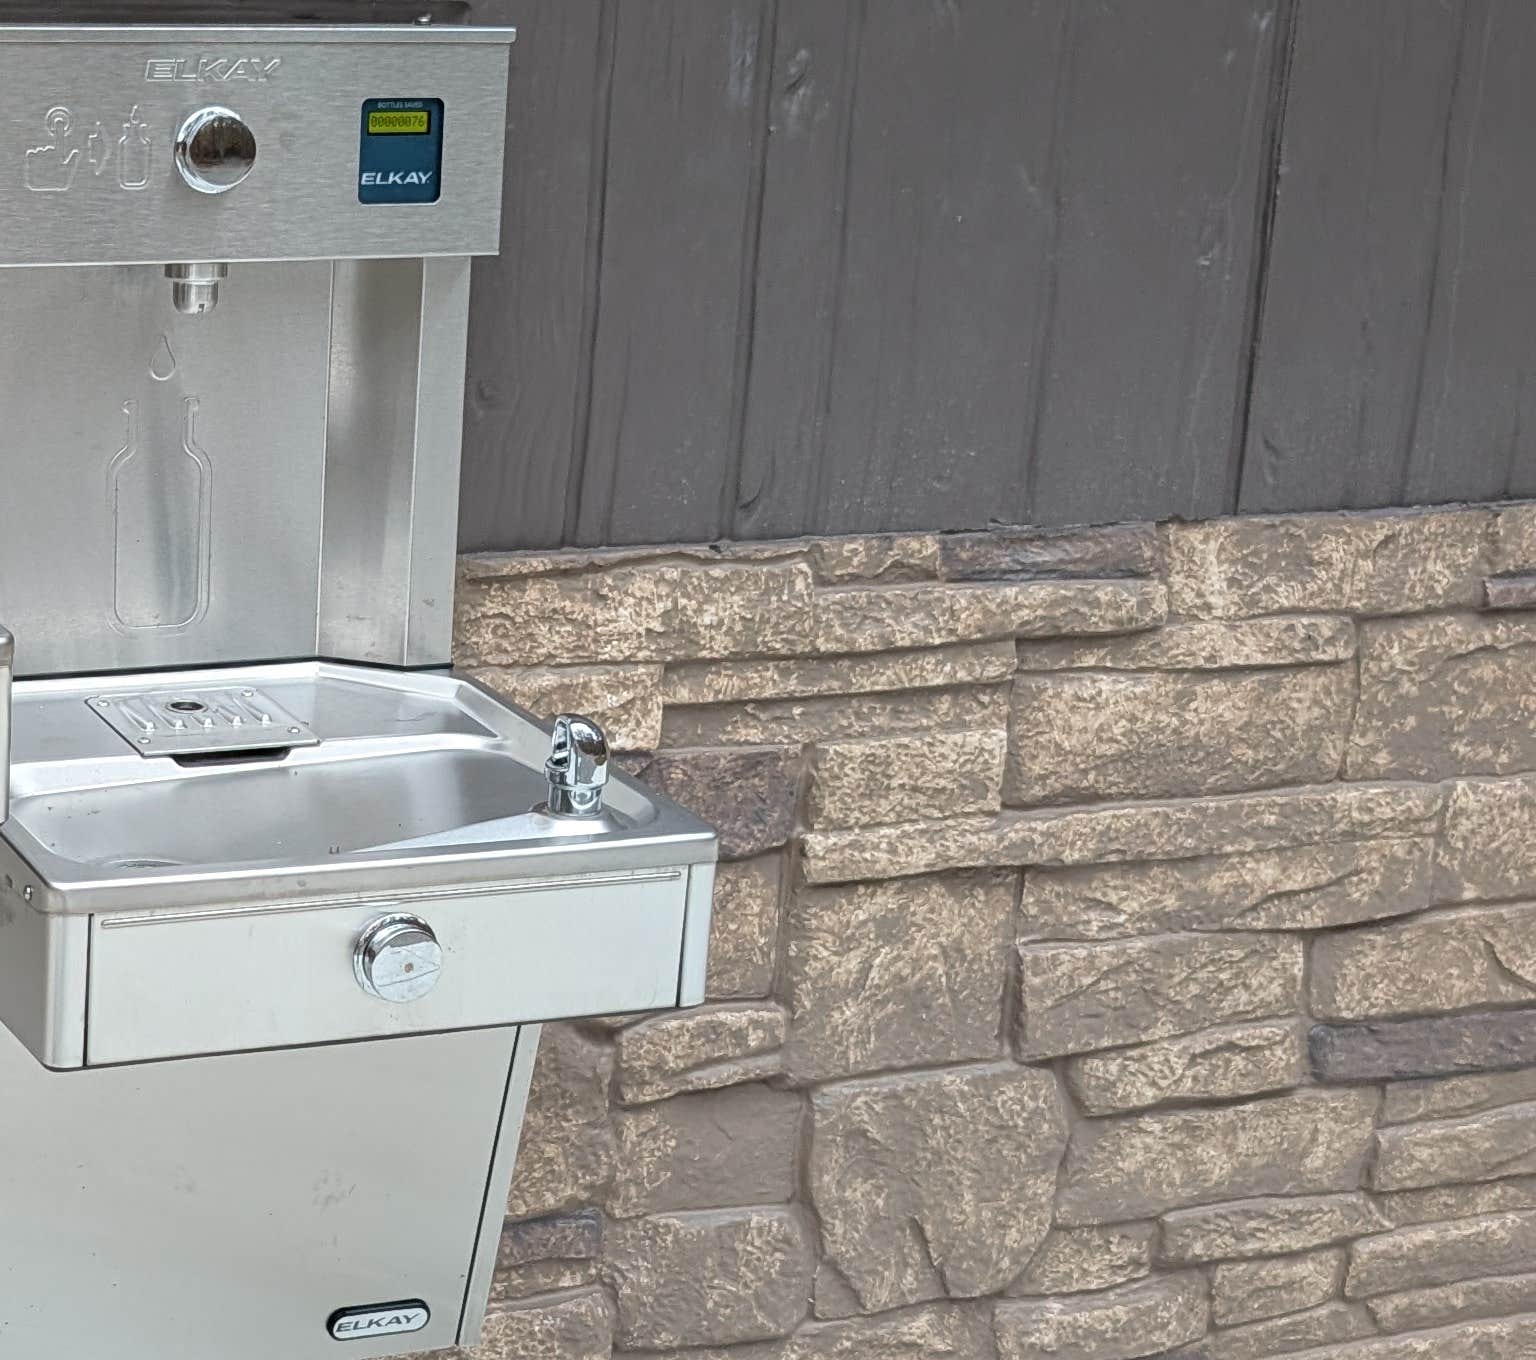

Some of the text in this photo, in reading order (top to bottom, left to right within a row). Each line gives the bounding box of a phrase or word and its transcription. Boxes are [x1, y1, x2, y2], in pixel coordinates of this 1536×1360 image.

[144, 57, 281, 82] ELKAY
[360, 171, 432, 185] ELKAY
[336, 1313, 420, 1332] ELKAY
